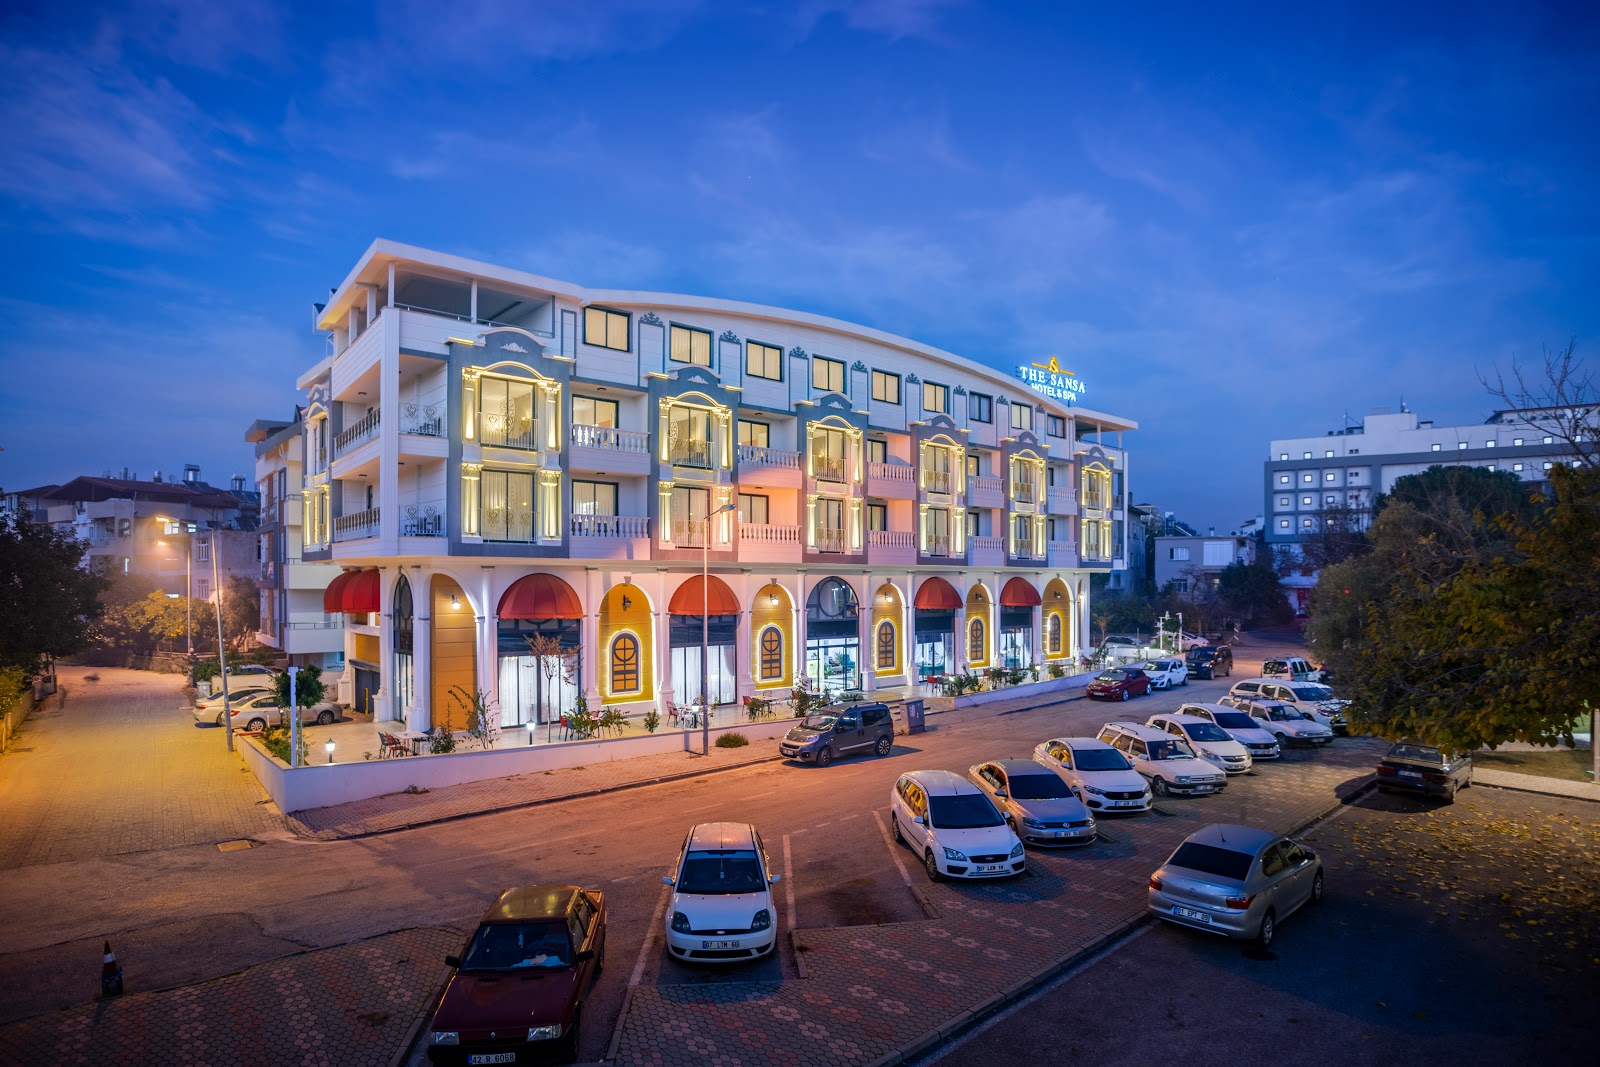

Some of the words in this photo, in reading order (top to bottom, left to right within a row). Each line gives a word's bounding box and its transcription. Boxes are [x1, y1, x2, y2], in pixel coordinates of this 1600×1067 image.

[1020, 366, 1045, 383] THE
[1050, 373, 1085, 393] SANSA
[1031, 382, 1056, 397] HOTEL
[1062, 390, 1076, 401] SPA
[1177, 907, 1184, 915] 01
[1187, 910, 1197, 918] EPT
[472, 1056, 482, 1064] 42
[494, 1053, 515, 1063] 6068
